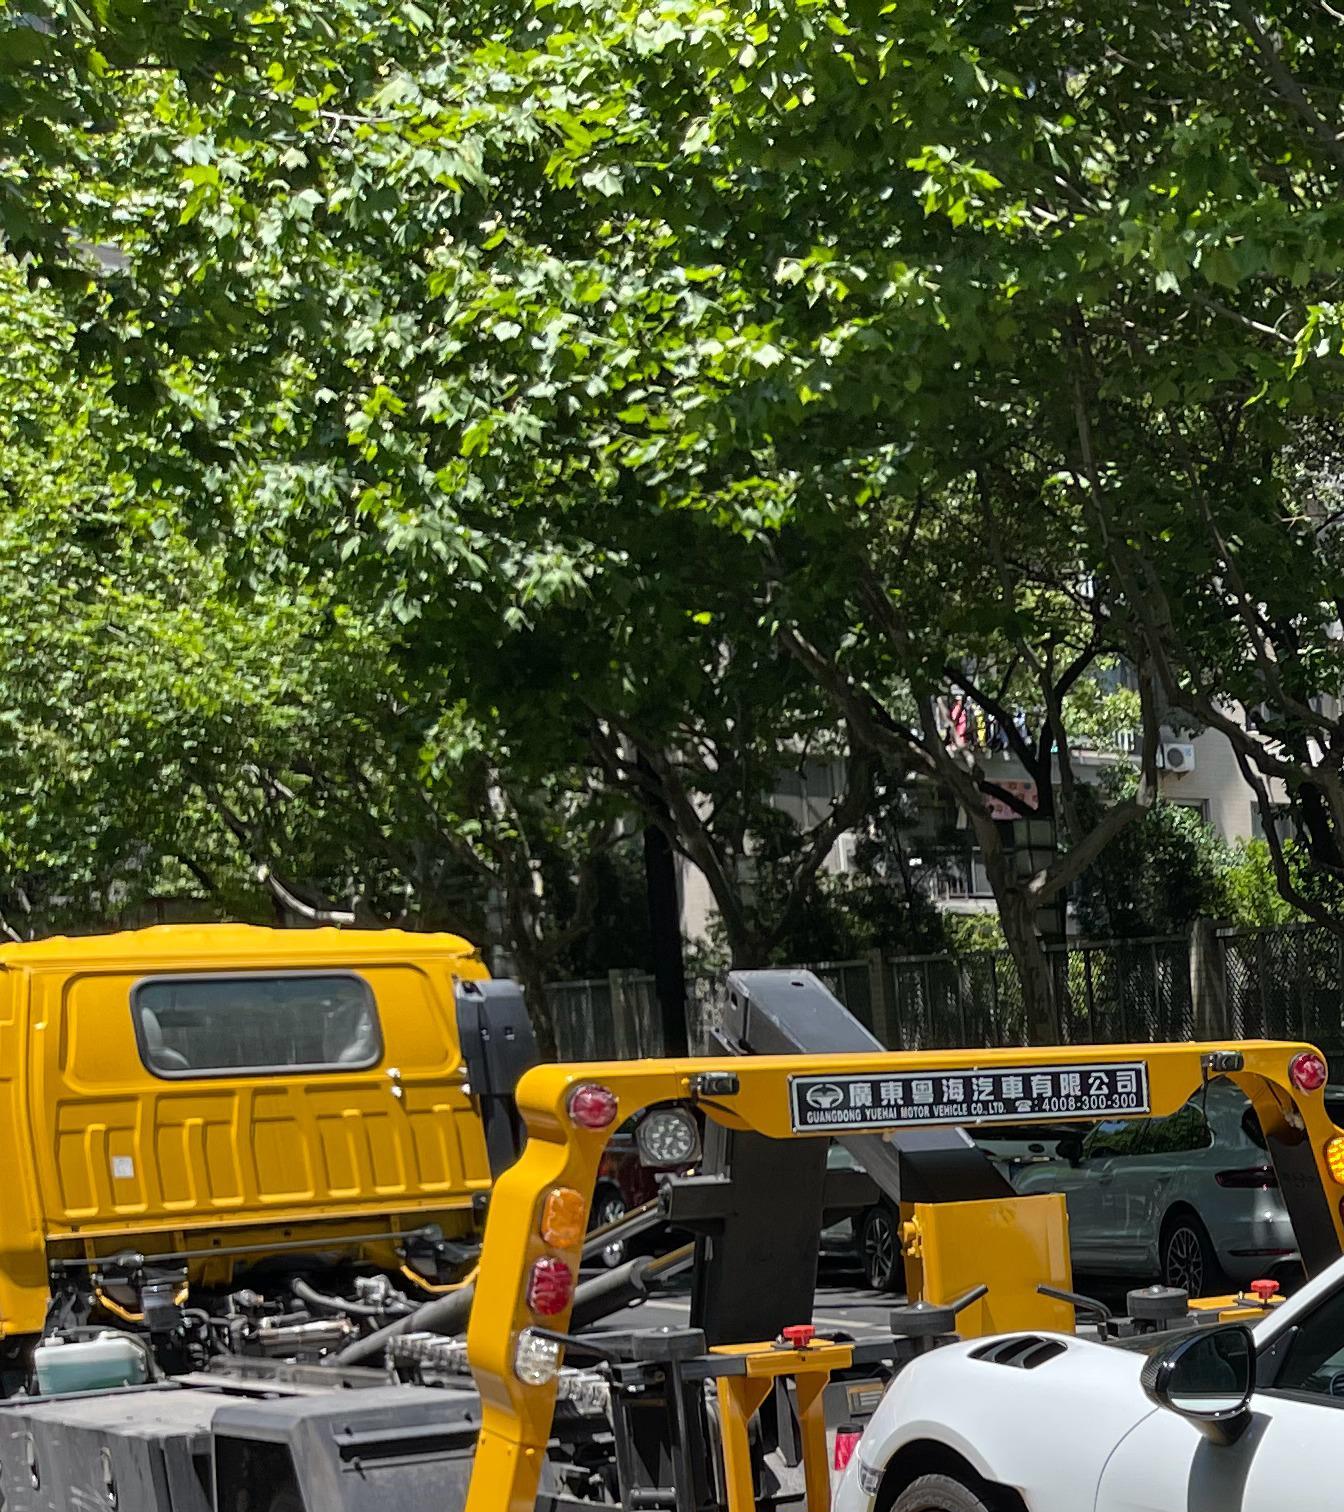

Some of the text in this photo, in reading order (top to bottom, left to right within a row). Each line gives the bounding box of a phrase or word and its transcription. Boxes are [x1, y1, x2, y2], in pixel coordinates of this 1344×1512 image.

[806, 1108, 862, 1124] GUANGDONG
[864, 1106, 897, 1121] YUEHAI
[900, 1105, 930, 1119] MOTOR
[933, 1103, 968, 1117] VEHICLE
